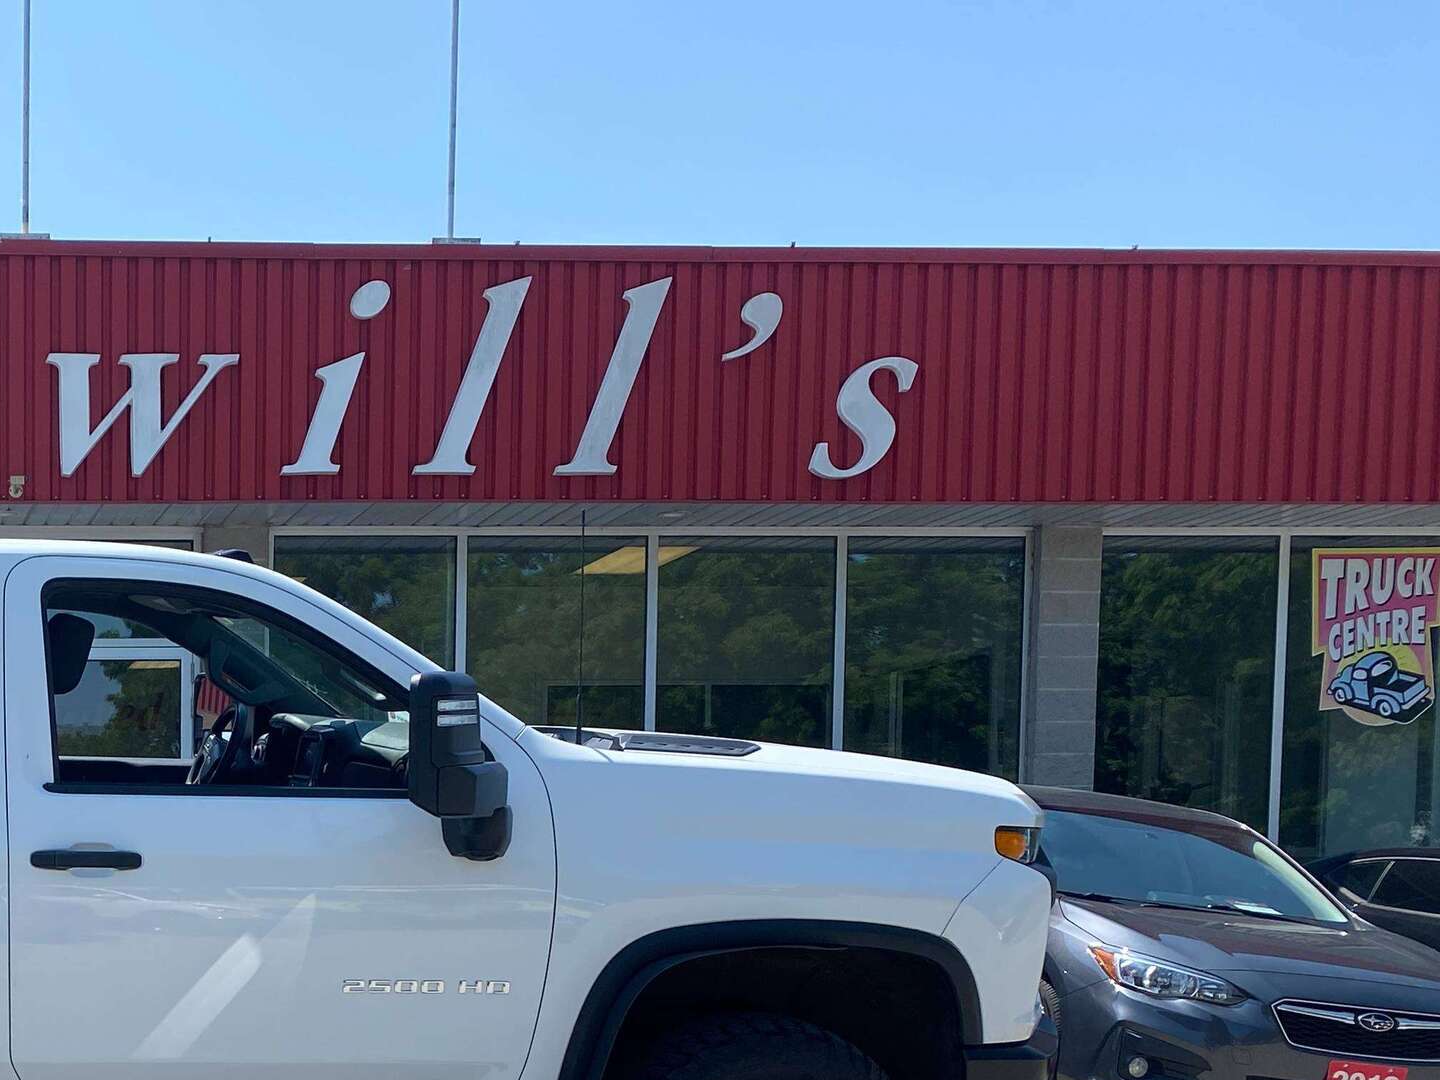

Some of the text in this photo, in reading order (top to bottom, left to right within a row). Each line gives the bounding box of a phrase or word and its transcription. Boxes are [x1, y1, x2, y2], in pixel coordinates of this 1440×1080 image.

[1321, 557, 1436, 620] TRUCK
[1328, 605, 1426, 662] CENTRE
[342, 979, 511, 994] 2500 HD
